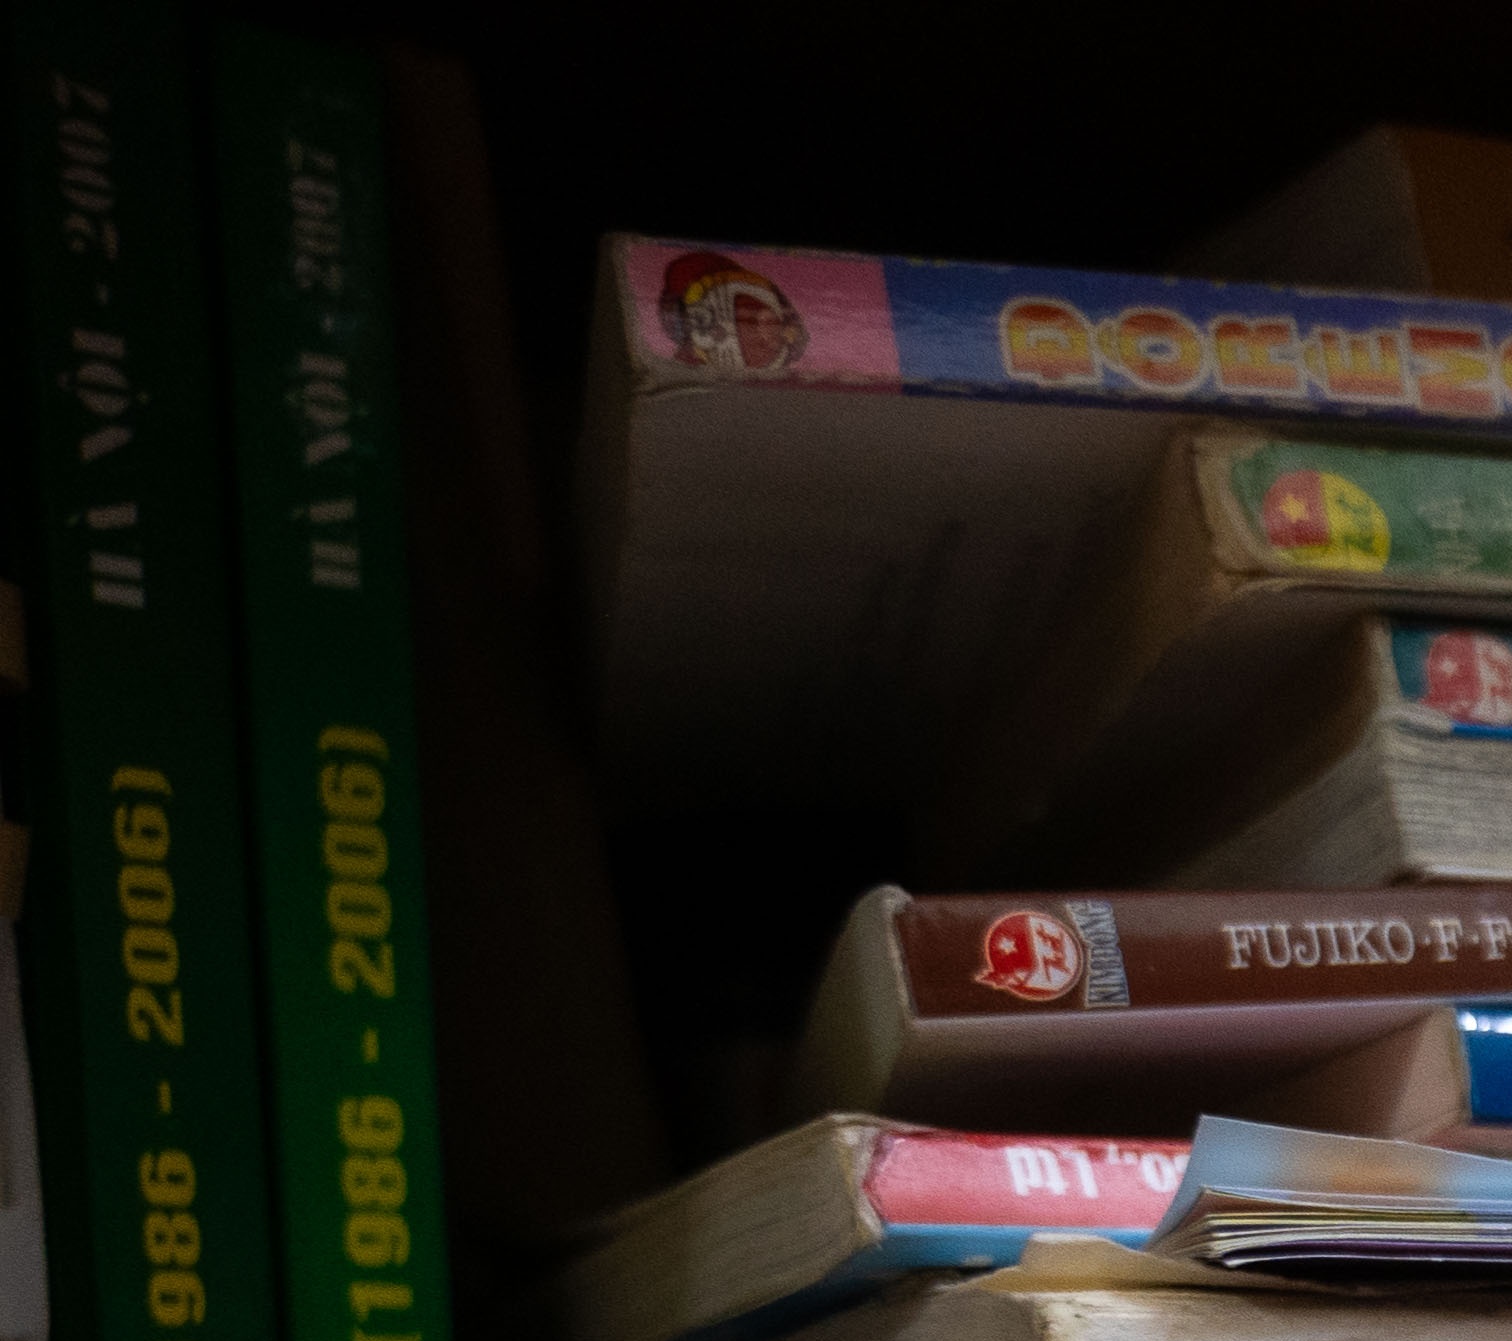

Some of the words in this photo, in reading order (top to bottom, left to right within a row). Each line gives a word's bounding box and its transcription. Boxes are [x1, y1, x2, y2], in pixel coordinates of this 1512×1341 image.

[110, 764, 185, 1047] 2006)
[315, 722, 398, 1000] 2006)
[1005, 1146, 1098, 1198] Ltd
